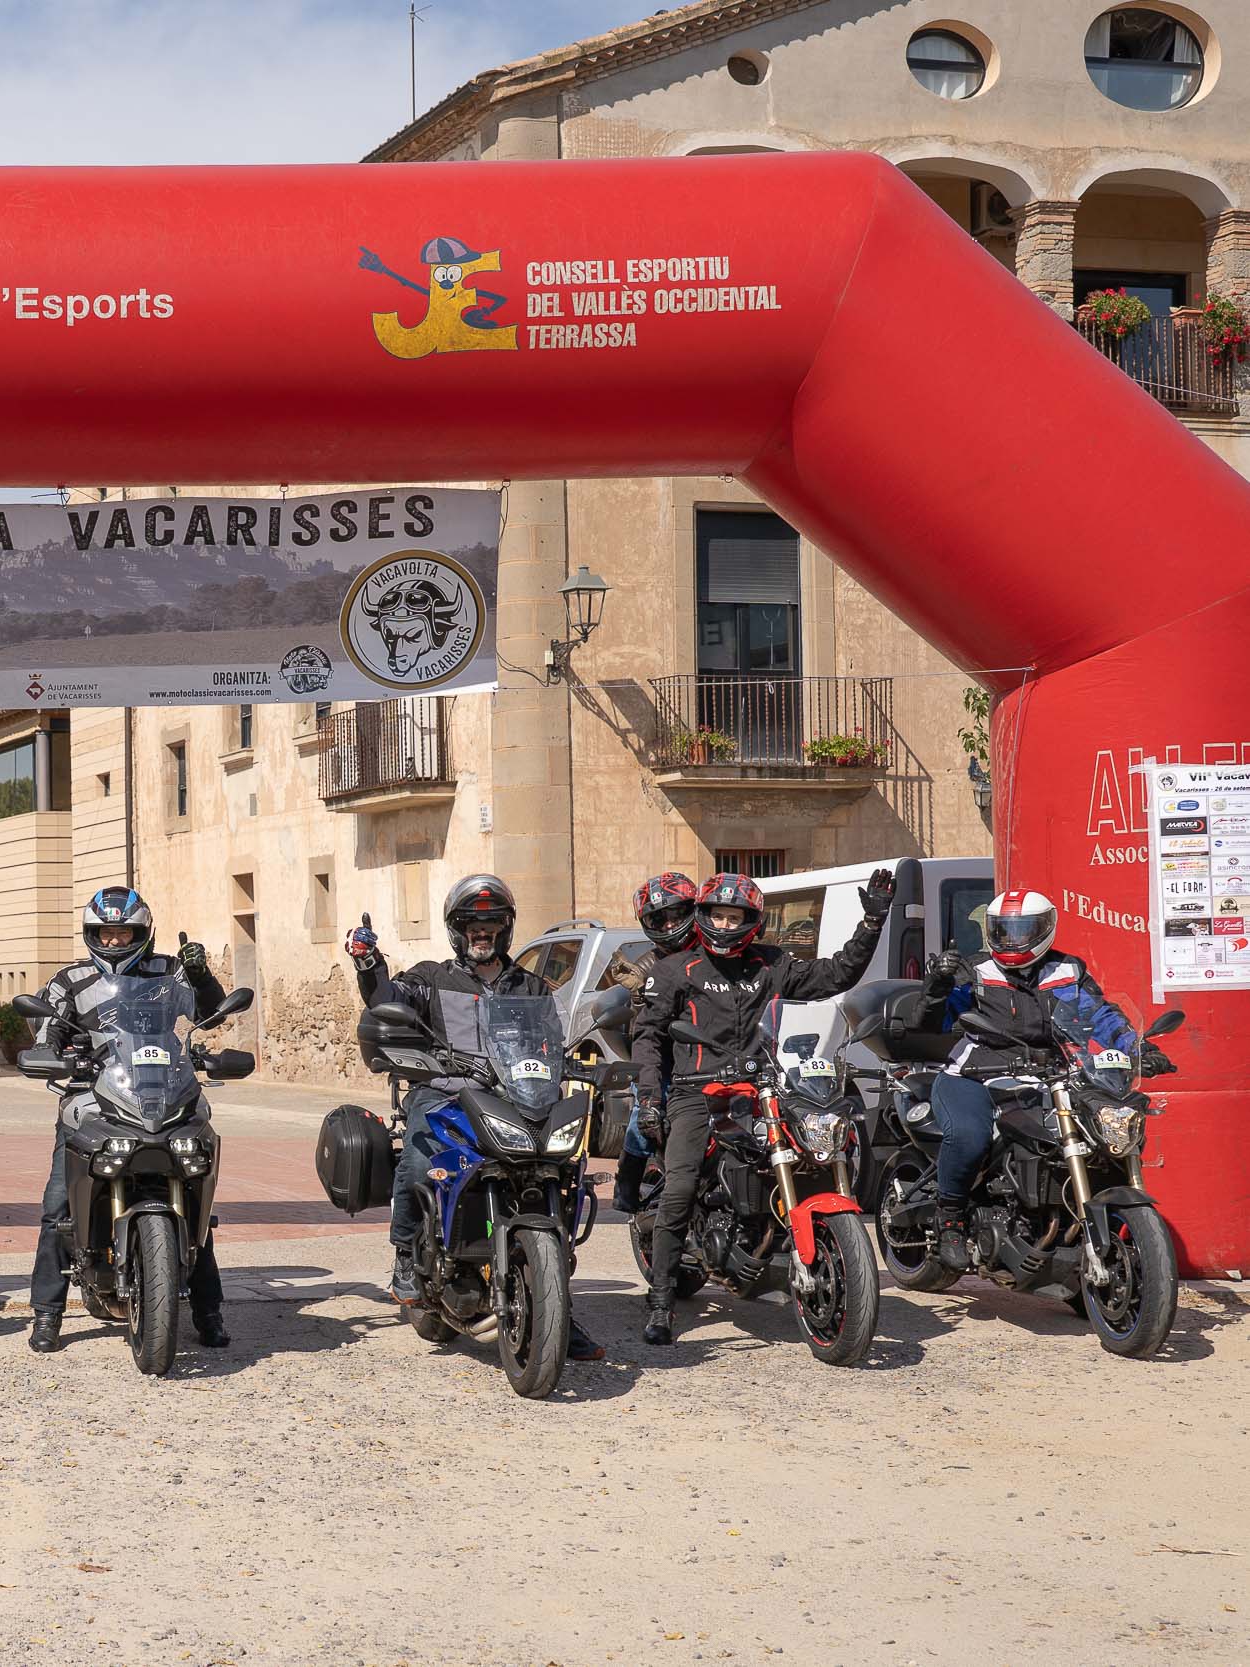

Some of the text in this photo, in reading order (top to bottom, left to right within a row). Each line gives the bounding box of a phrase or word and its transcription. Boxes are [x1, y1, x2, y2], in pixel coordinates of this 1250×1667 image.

[526, 257, 729, 285] CONSELL ESPORTIU
[527, 285, 782, 317] DEL VALLÈS OCCIDENTAL
[527, 323, 637, 349] TERRASSA
[68, 494, 435, 550] VACARISSES
[371, 562, 439, 588] VACAVOLTA
[416, 626, 472, 680] VACARISSES
[213, 672, 271, 685] ORGANITZA:
[149, 688, 272, 698] www.motoclassicvacarisses.com
[144, 1049, 158, 1058] 85
[1106, 1052, 1120, 1062] 81
[524, 1062, 540, 1072] 82
[811, 1060, 826, 1070] 83
